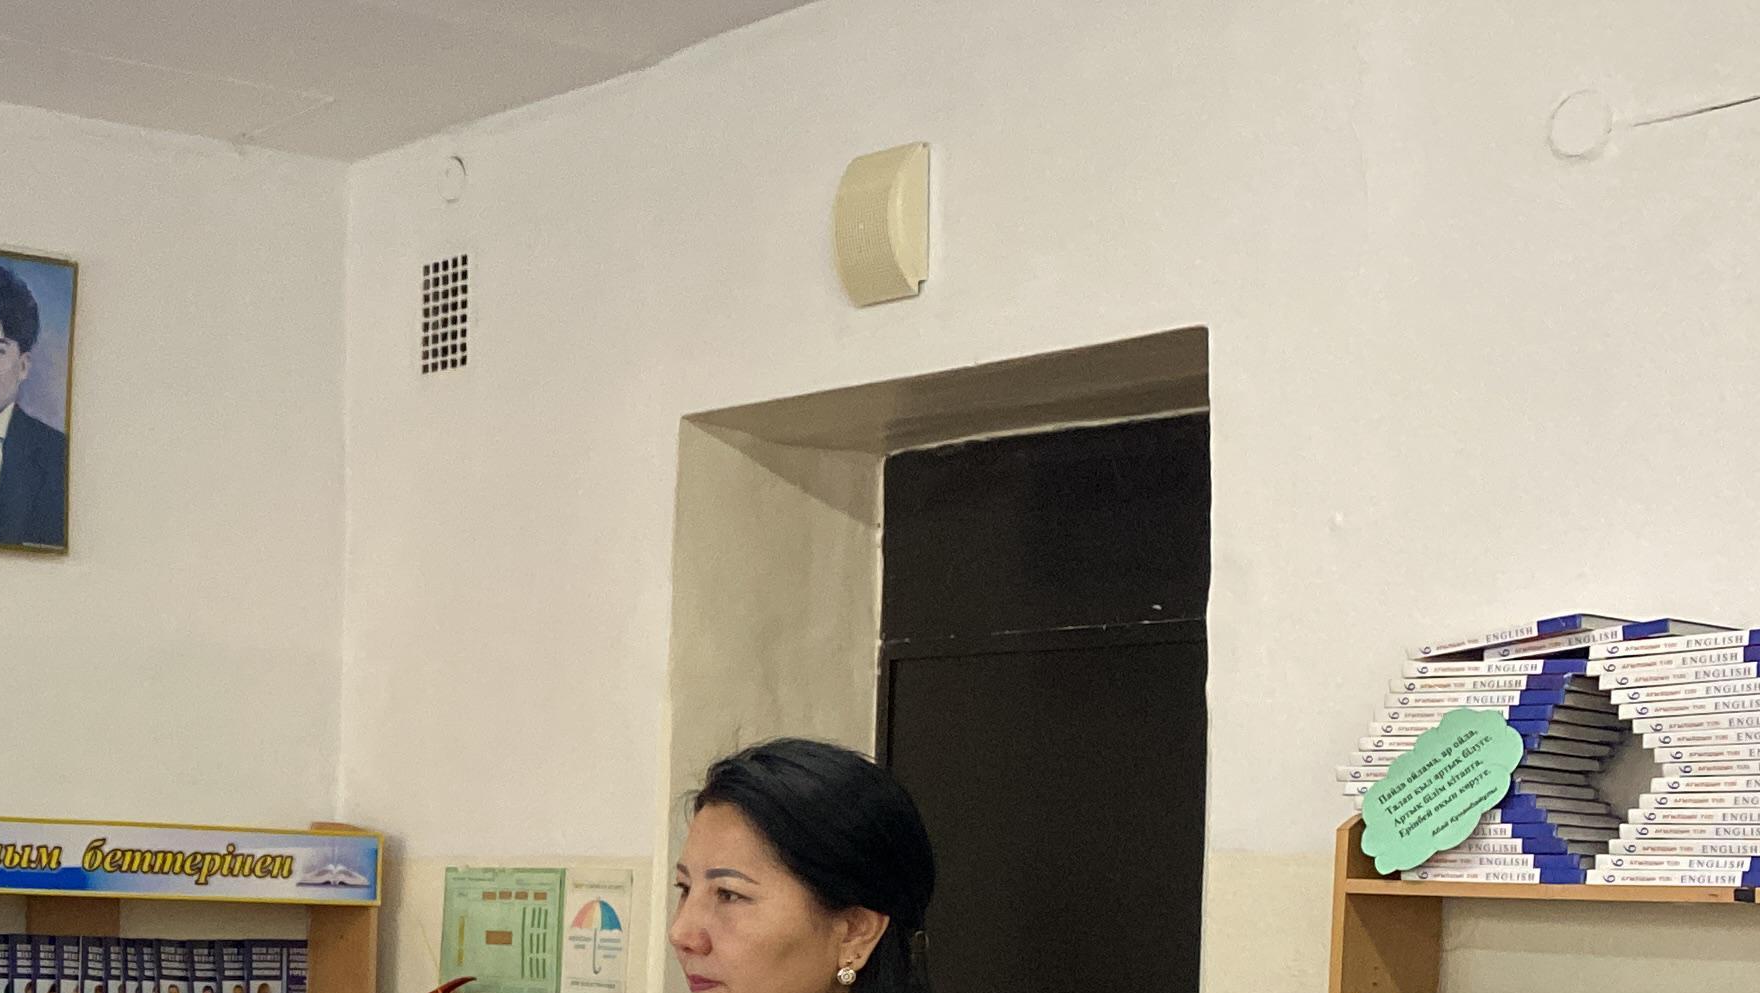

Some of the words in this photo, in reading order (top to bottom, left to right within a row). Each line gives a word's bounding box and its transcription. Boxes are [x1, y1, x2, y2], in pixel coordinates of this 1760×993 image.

[1485, 626, 1533, 643] ENGLISH
[1568, 630, 1618, 646] ENGLISH
[1686, 635, 1743, 649] ENGLISH
[1682, 652, 1738, 666] ENGLISH
[1487, 663, 1538, 673] ENGLISH
[1695, 666, 1752, 680] ENGLISH
[1472, 680, 1522, 689] ENGLISH
[1466, 695, 1515, 704] ENGLISH
[1714, 700, 1760, 711] ENGLIS
[1728, 717, 1760, 727] ENGL
[1715, 827, 1760, 836] ENGLIS
[1701, 845, 1758, 854] ENGLISH
[81, 838, 295, 885] беттерінен
[1479, 857, 1529, 866] ENGLISH
[1688, 859, 1745, 868] ENGLISH
[1485, 872, 1535, 882] ENGLISH
[1681, 874, 1736, 884] ENGLISH
